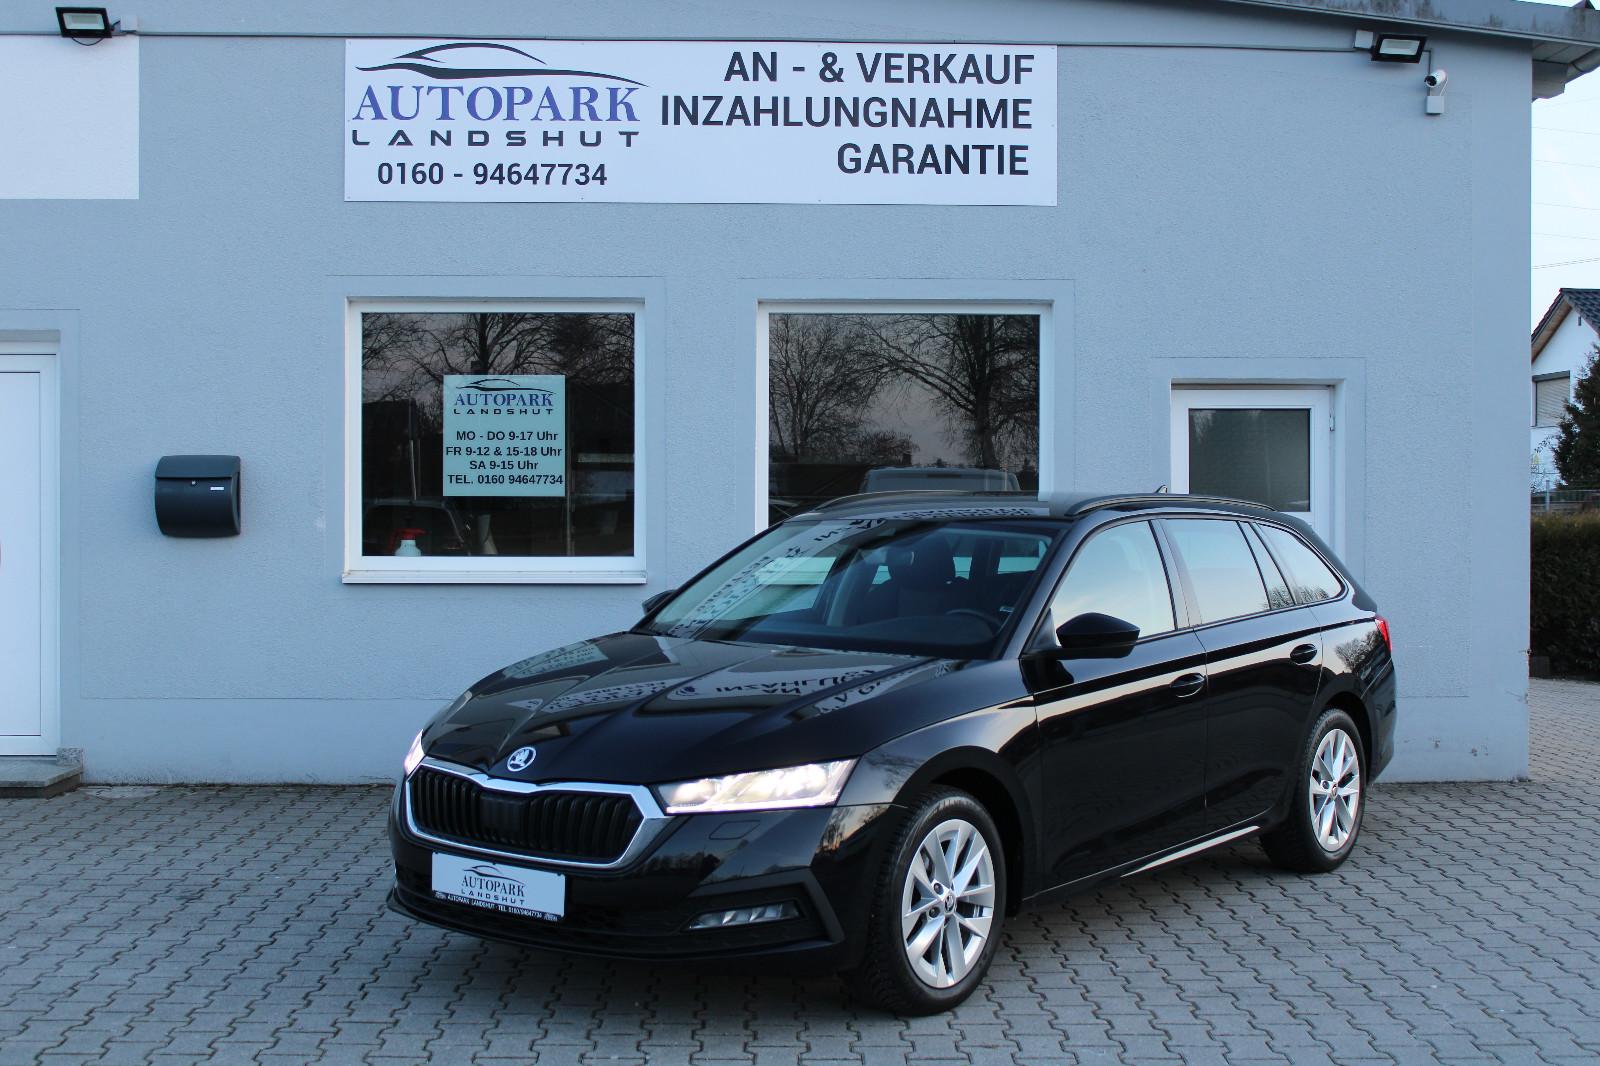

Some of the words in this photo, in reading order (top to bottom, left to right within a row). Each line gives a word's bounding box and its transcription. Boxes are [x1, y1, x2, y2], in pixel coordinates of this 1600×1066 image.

[723, 51, 778, 82] AN
[818, 51, 845, 83] &
[855, 52, 1035, 85] VERKAUF
[352, 84, 641, 122] AUTOPARK
[661, 95, 1033, 130] INZAHLUNGNAHME
[351, 129, 640, 148] LANDSHUT
[837, 142, 1029, 176] GARANTIE
[377, 162, 444, 185] 0160
[473, 162, 608, 186] 94647734
[455, 393, 553, 407] AUTOPARK
[456, 430, 476, 441] MO
[487, 430, 506, 441] DO
[508, 431, 534, 441] 9-17
[536, 430, 559, 441] Uhr
[445, 446, 462, 456] FR
[465, 446, 491, 456] 9-12
[493, 446, 503, 457] &
[506, 446, 538, 457] 15-18
[540, 446, 563, 457] Uhr
[469, 460, 487, 470] SA
[489, 460, 515, 470] 9-15
[517, 459, 539, 470] Uhr
[447, 474, 474, 485] TEL.
[477, 474, 505, 485] 0160
[508, 474, 564, 485] 94647734
[461, 875, 525, 897] AUTOPARK
[461, 889, 525, 905] LANDSHUT
